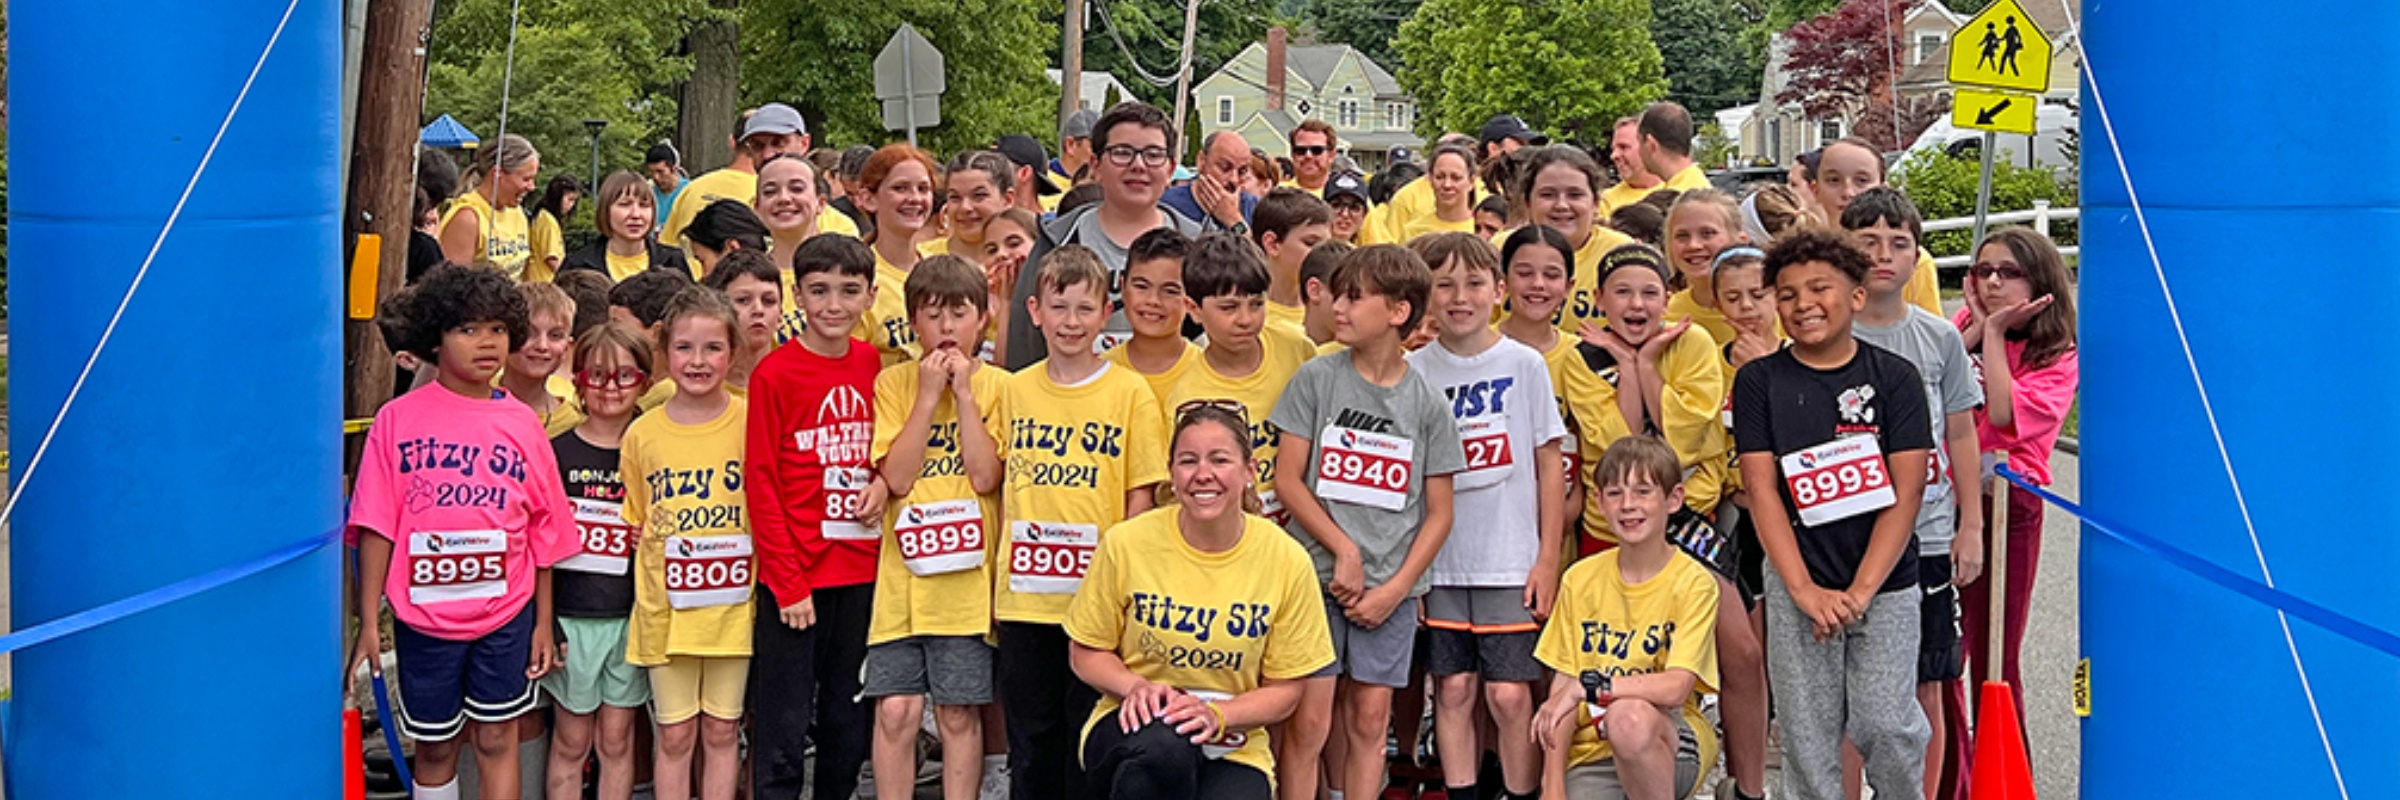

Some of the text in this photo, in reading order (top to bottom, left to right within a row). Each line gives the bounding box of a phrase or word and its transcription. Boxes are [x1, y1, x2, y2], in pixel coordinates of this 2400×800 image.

[885, 316, 914, 348] Fit
[1445, 376, 1514, 418] UST
[1334, 407, 1394, 433] NIKE
[1081, 422, 1122, 457] 5K
[1466, 437, 1505, 468] 27
[398, 437, 481, 477] Fitzy
[921, 454, 967, 478] 202
[1321, 451, 1408, 489] 8940
[723, 460, 741, 492] 5
[1033, 462, 1099, 489] 2024
[1794, 458, 1884, 504] 8993
[437, 482, 507, 510] 2024
[825, 493, 860, 519] 89
[677, 505, 742, 533] 2024
[900, 522, 982, 558] 8899
[413, 556, 503, 584] 8995
[666, 559, 749, 589] 8806
[1012, 545, 1094, 575] 8905
[1132, 592, 1271, 643] Fitzy 5K
[1168, 645, 1244, 672] 2024
